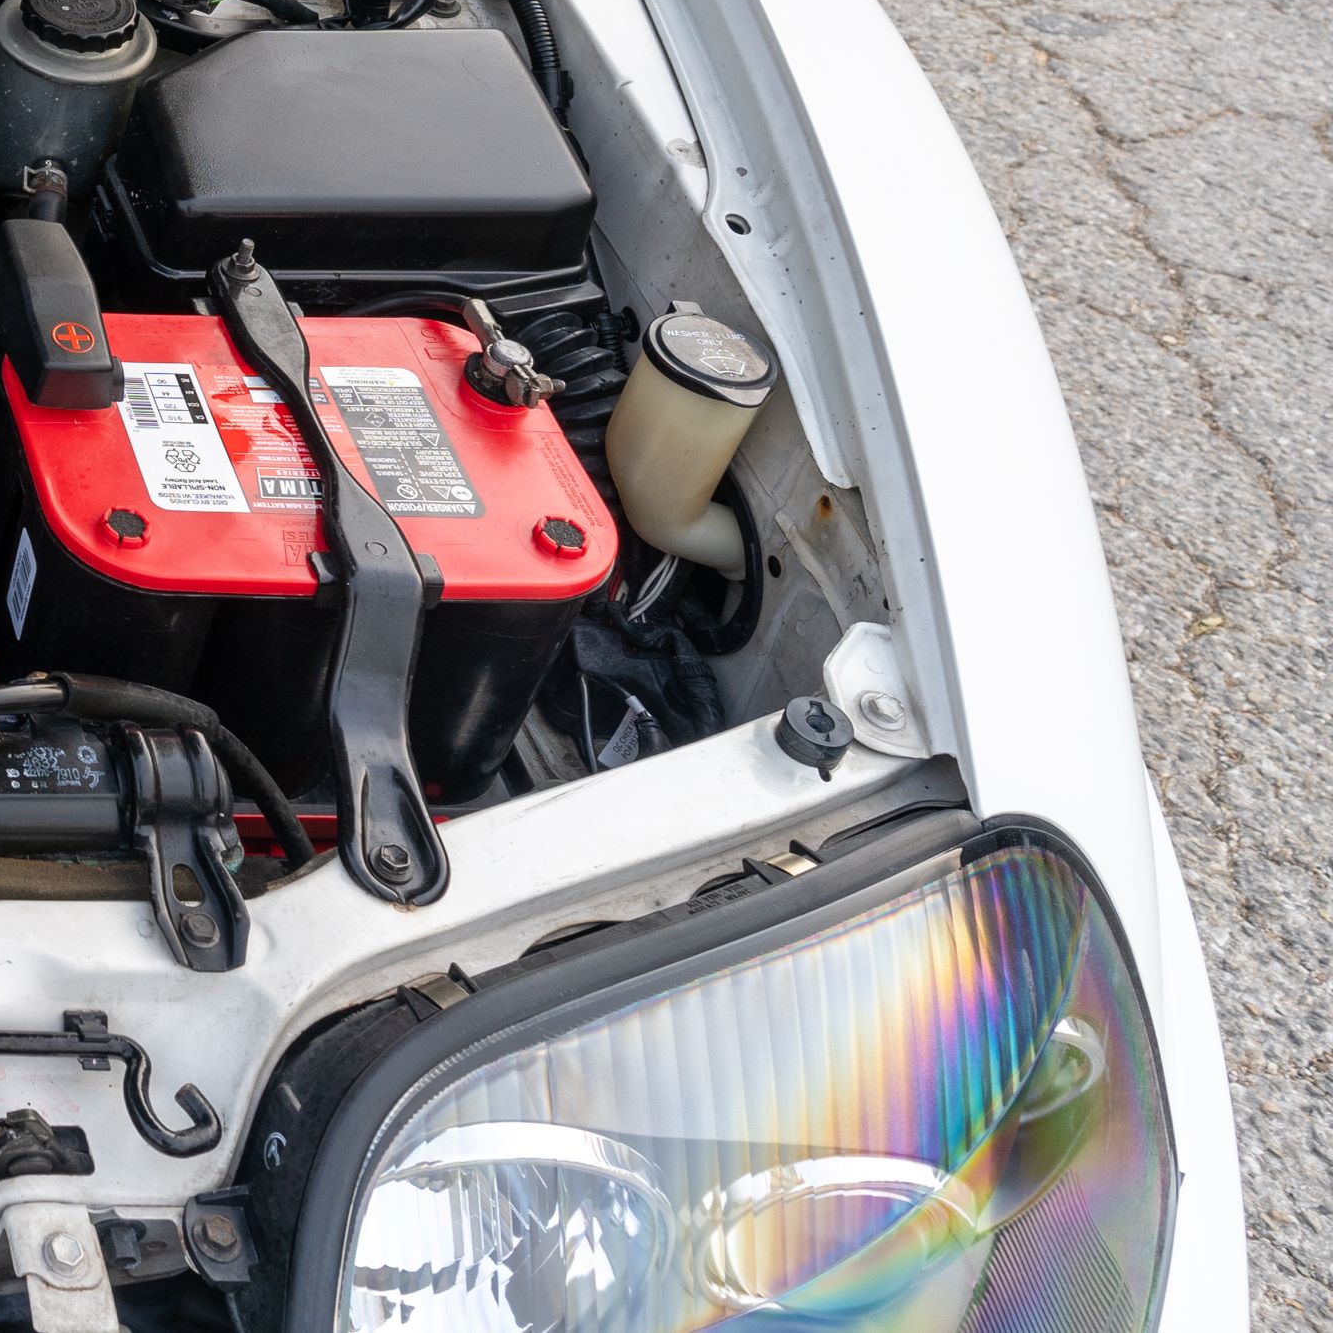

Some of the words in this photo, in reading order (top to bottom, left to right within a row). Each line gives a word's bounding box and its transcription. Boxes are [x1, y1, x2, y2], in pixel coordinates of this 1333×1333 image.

[664, 329, 711, 338] WASHER
[715, 332, 746, 341] FLUID
[696, 338, 723, 347] ONLY
[161, 483, 226, 491] NON-SPILLABLE
[387, 502, 465, 513] DANGER/POISON
